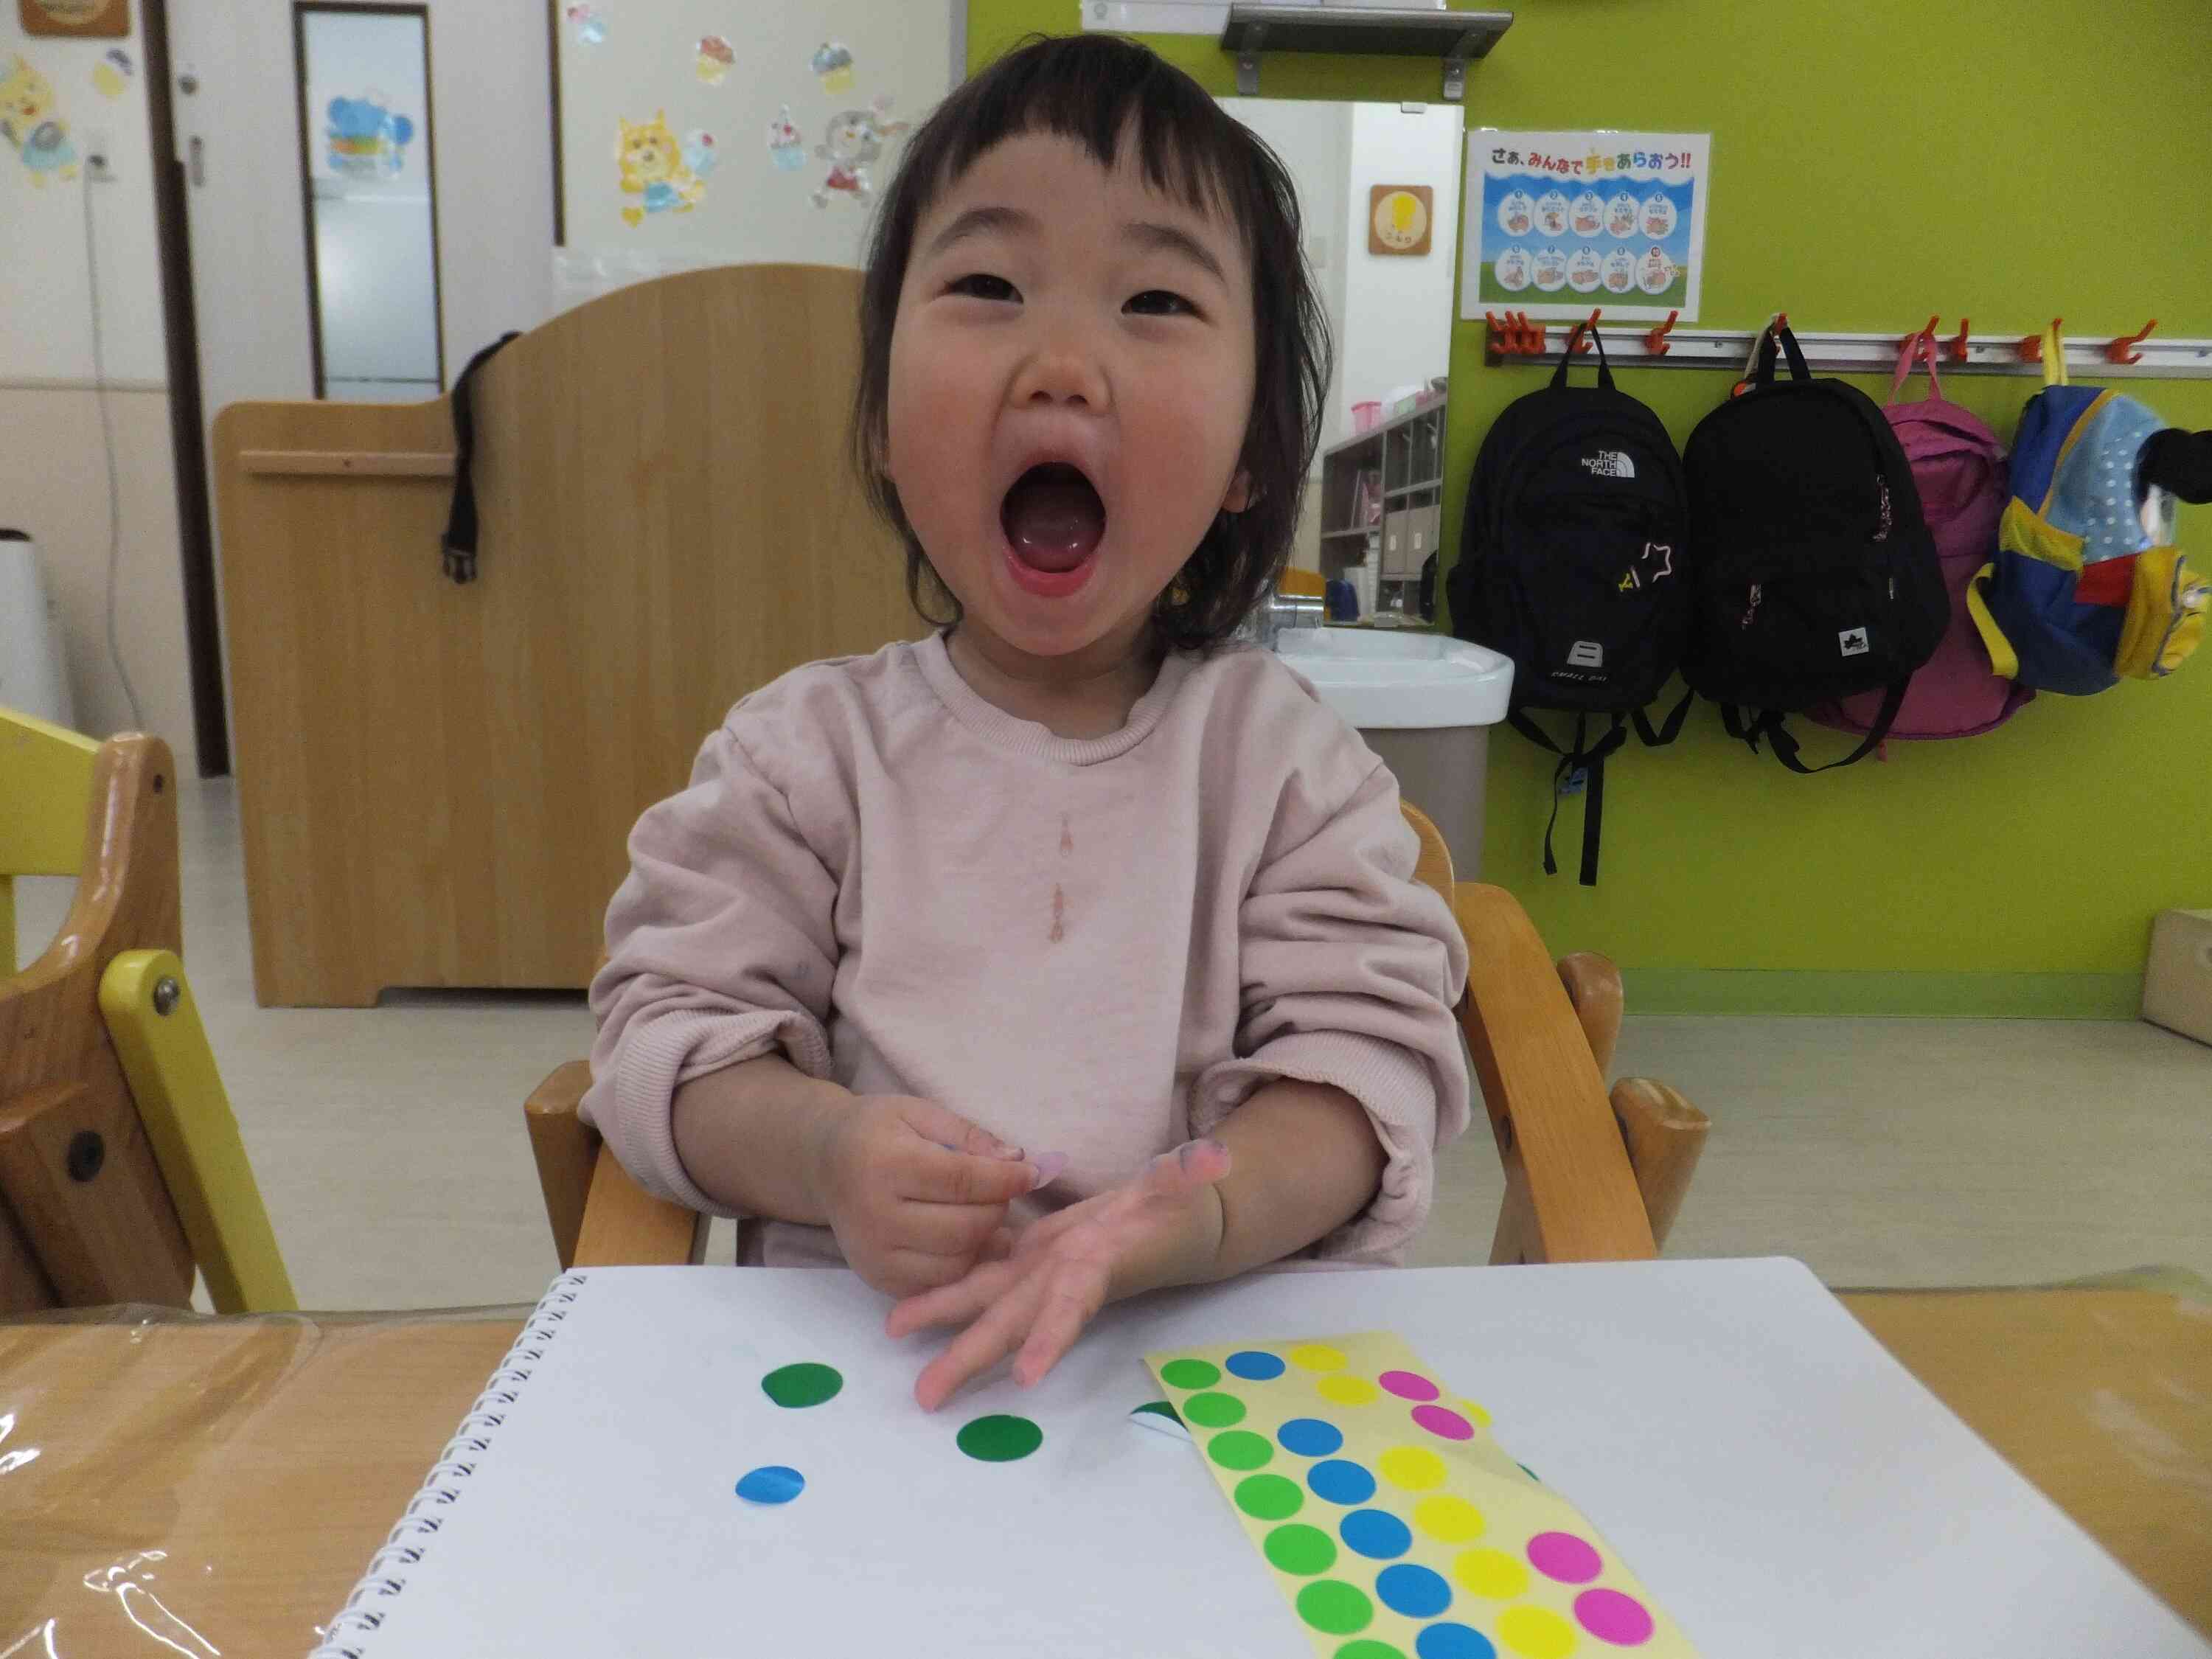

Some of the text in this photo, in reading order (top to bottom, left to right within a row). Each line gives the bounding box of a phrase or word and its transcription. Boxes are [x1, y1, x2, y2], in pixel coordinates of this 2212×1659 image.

[1599, 451, 1617, 461] THE
[1582, 458, 1617, 468] NORTH
[1591, 467, 1617, 477] FACE
